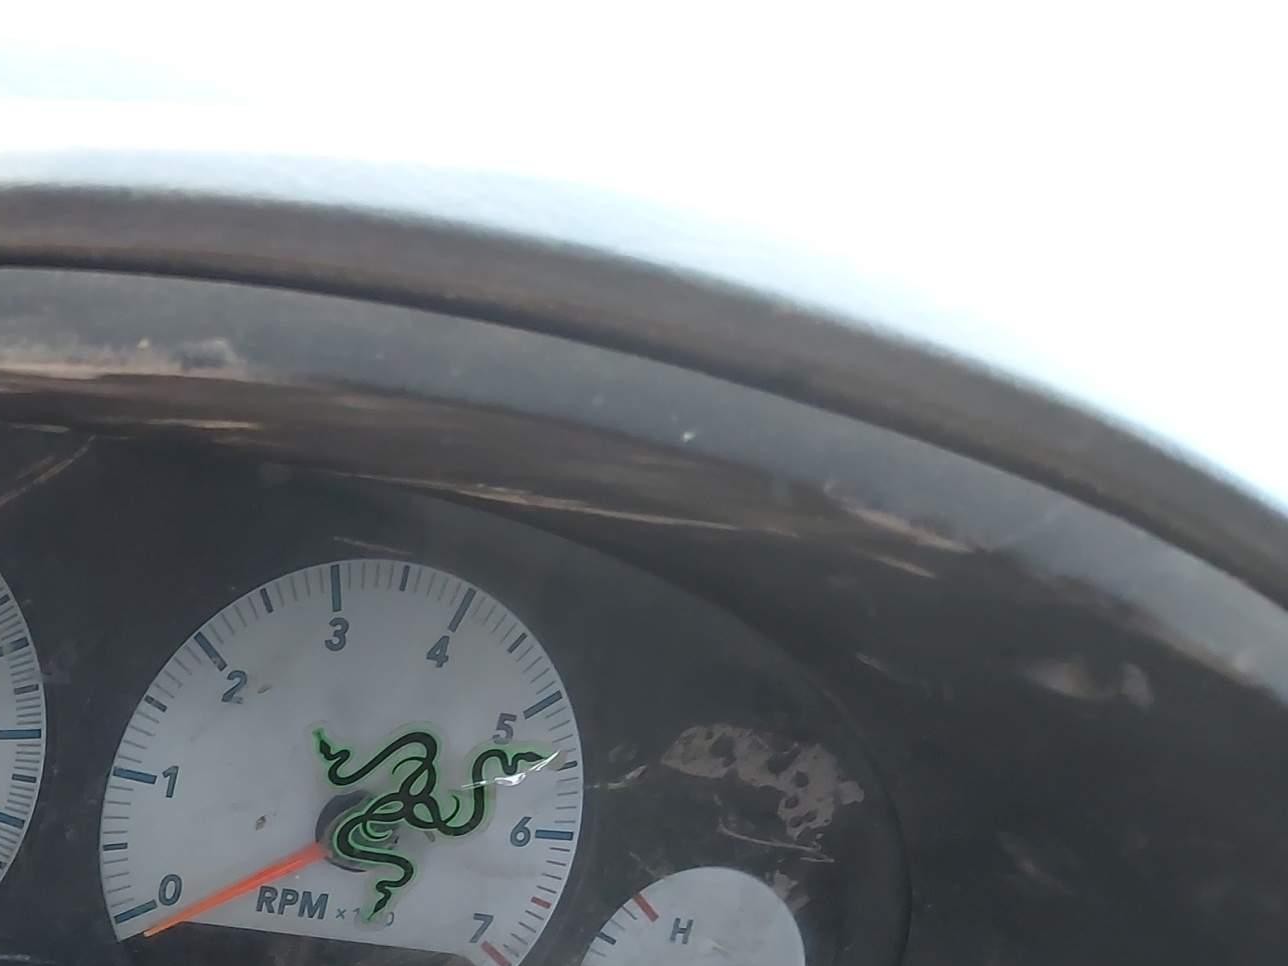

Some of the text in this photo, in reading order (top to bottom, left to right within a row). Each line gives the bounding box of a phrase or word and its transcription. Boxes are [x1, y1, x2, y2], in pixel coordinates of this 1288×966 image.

[324, 618, 349, 652] 3
[426, 636, 449, 668] 4
[222, 671, 248, 702] 2
[494, 713, 517, 745] 5
[162, 766, 180, 798] 1
[510, 817, 532, 847] 6
[158, 873, 183, 906] 0
[256, 886, 329, 920] RPM
[469, 913, 494, 944] 7
[670, 917, 694, 944] H
